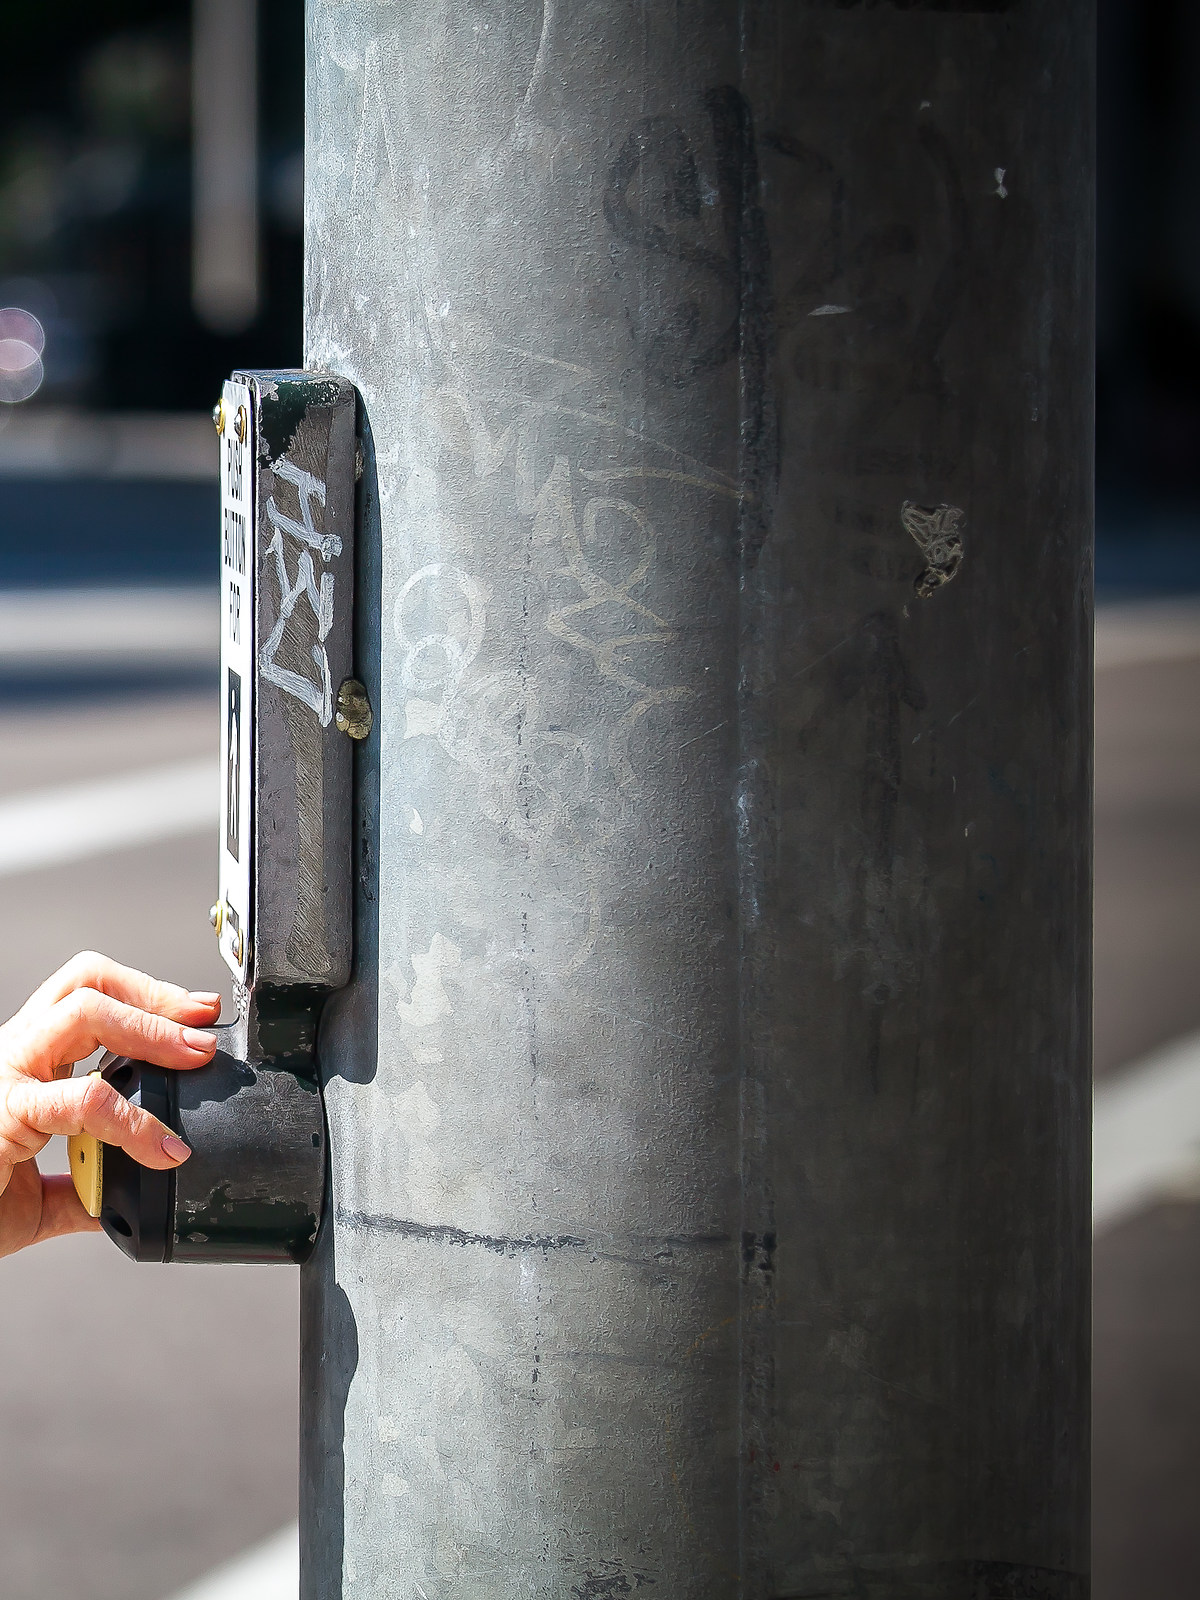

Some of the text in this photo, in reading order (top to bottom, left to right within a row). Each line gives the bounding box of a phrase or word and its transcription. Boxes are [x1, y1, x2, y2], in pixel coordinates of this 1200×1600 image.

[227, 438, 243, 501] PUSH
[224, 508, 246, 577] BUTTON
[229, 581, 241, 645] FOR
